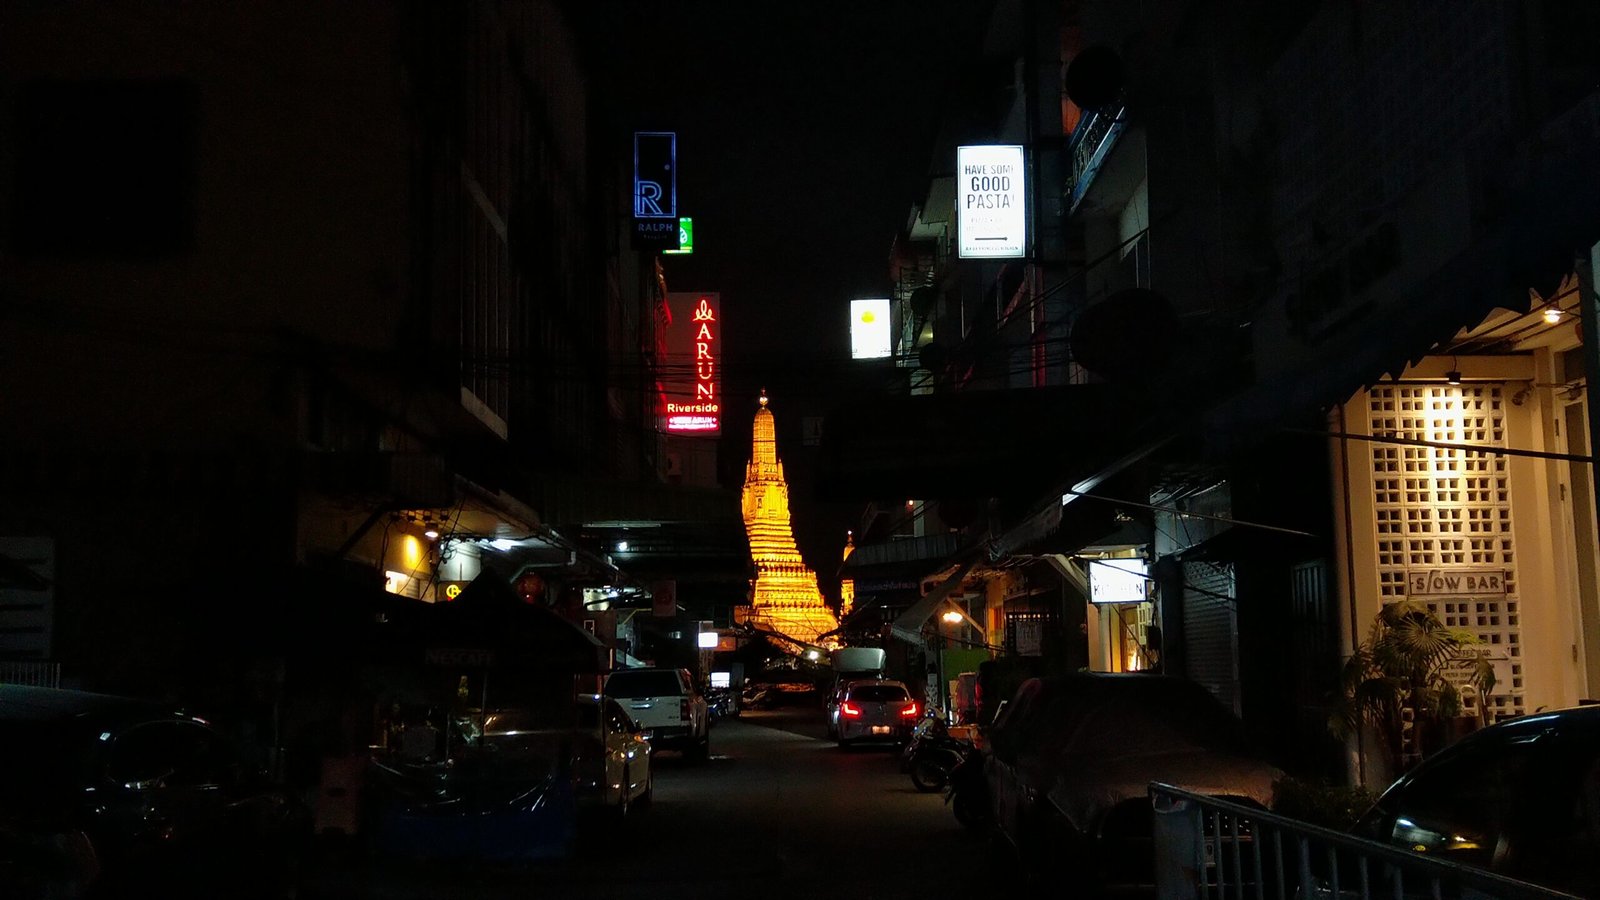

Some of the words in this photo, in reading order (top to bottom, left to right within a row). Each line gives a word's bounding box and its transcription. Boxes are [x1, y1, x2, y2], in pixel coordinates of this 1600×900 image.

[965, 164, 987, 175] HAVE
[971, 176, 1011, 192] GOOD
[638, 223, 673, 232] RALPH
[696, 322, 714, 400] ARUN
[667, 403, 718, 413] Riverside
[1466, 576, 1499, 589] BAR
[1093, 583, 1143, 596] KIEN
